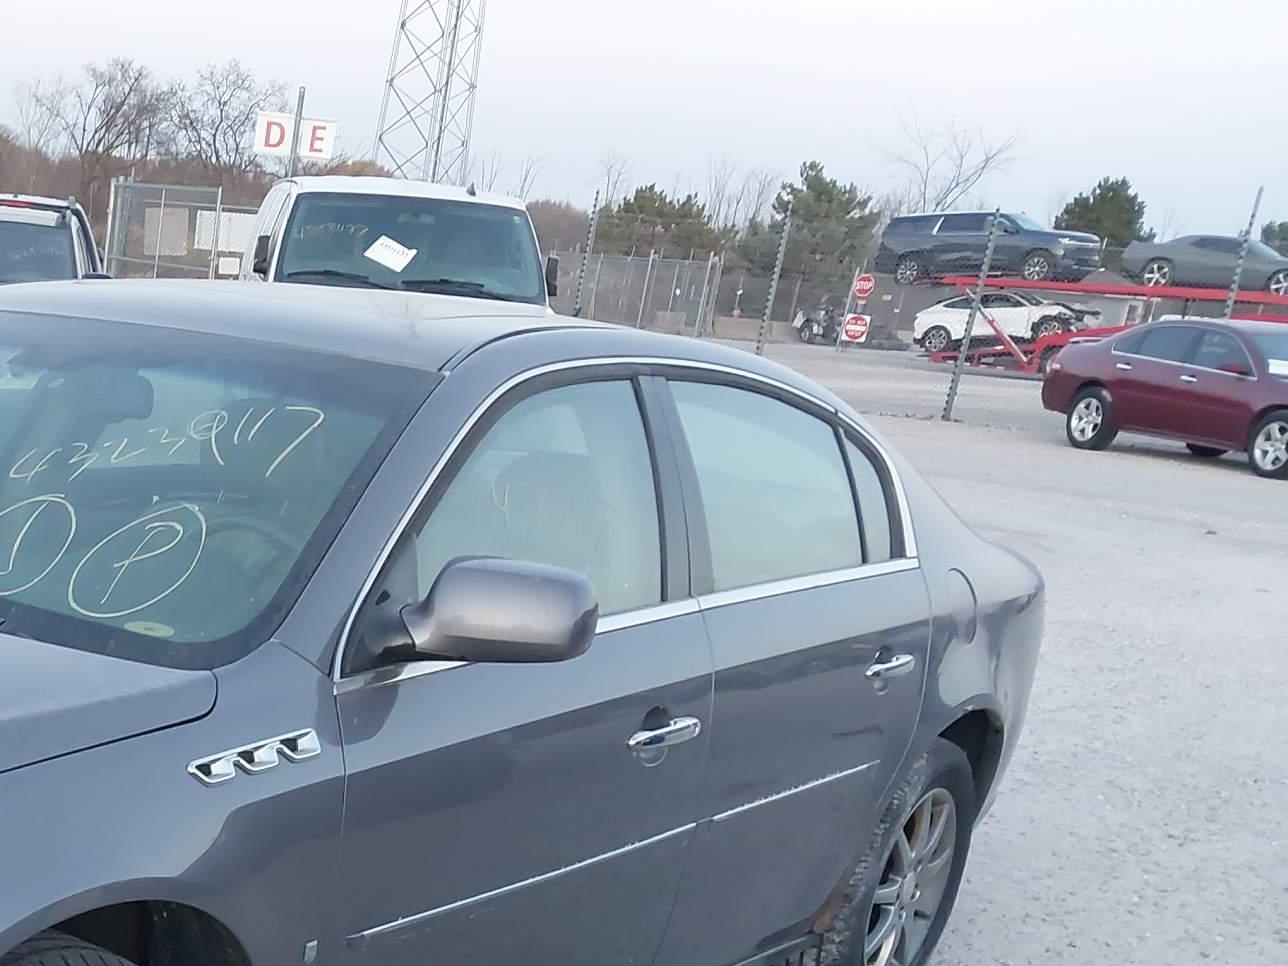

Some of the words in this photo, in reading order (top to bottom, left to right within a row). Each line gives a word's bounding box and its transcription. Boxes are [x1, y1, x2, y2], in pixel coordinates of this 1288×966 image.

[264, 120, 286, 148] D
[309, 125, 327, 153] E
[855, 280, 873, 290] STOP
